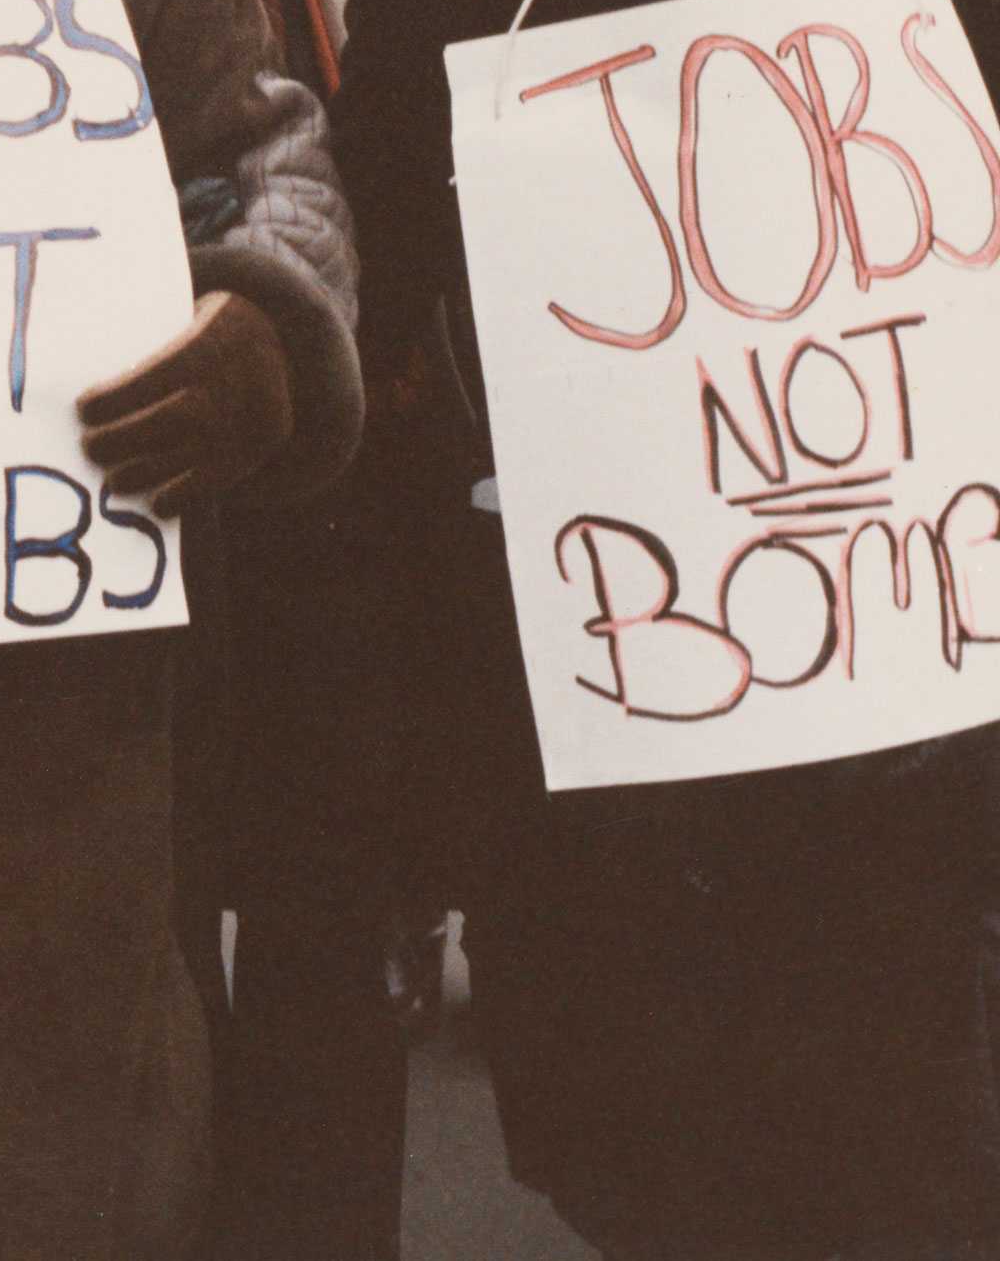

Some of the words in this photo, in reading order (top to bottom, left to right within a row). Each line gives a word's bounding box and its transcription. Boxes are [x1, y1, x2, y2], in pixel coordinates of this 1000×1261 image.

[519, 9, 1000, 351] JOBS
[695, 314, 927, 495] NOT
[553, 482, 1000, 723] BOMB
